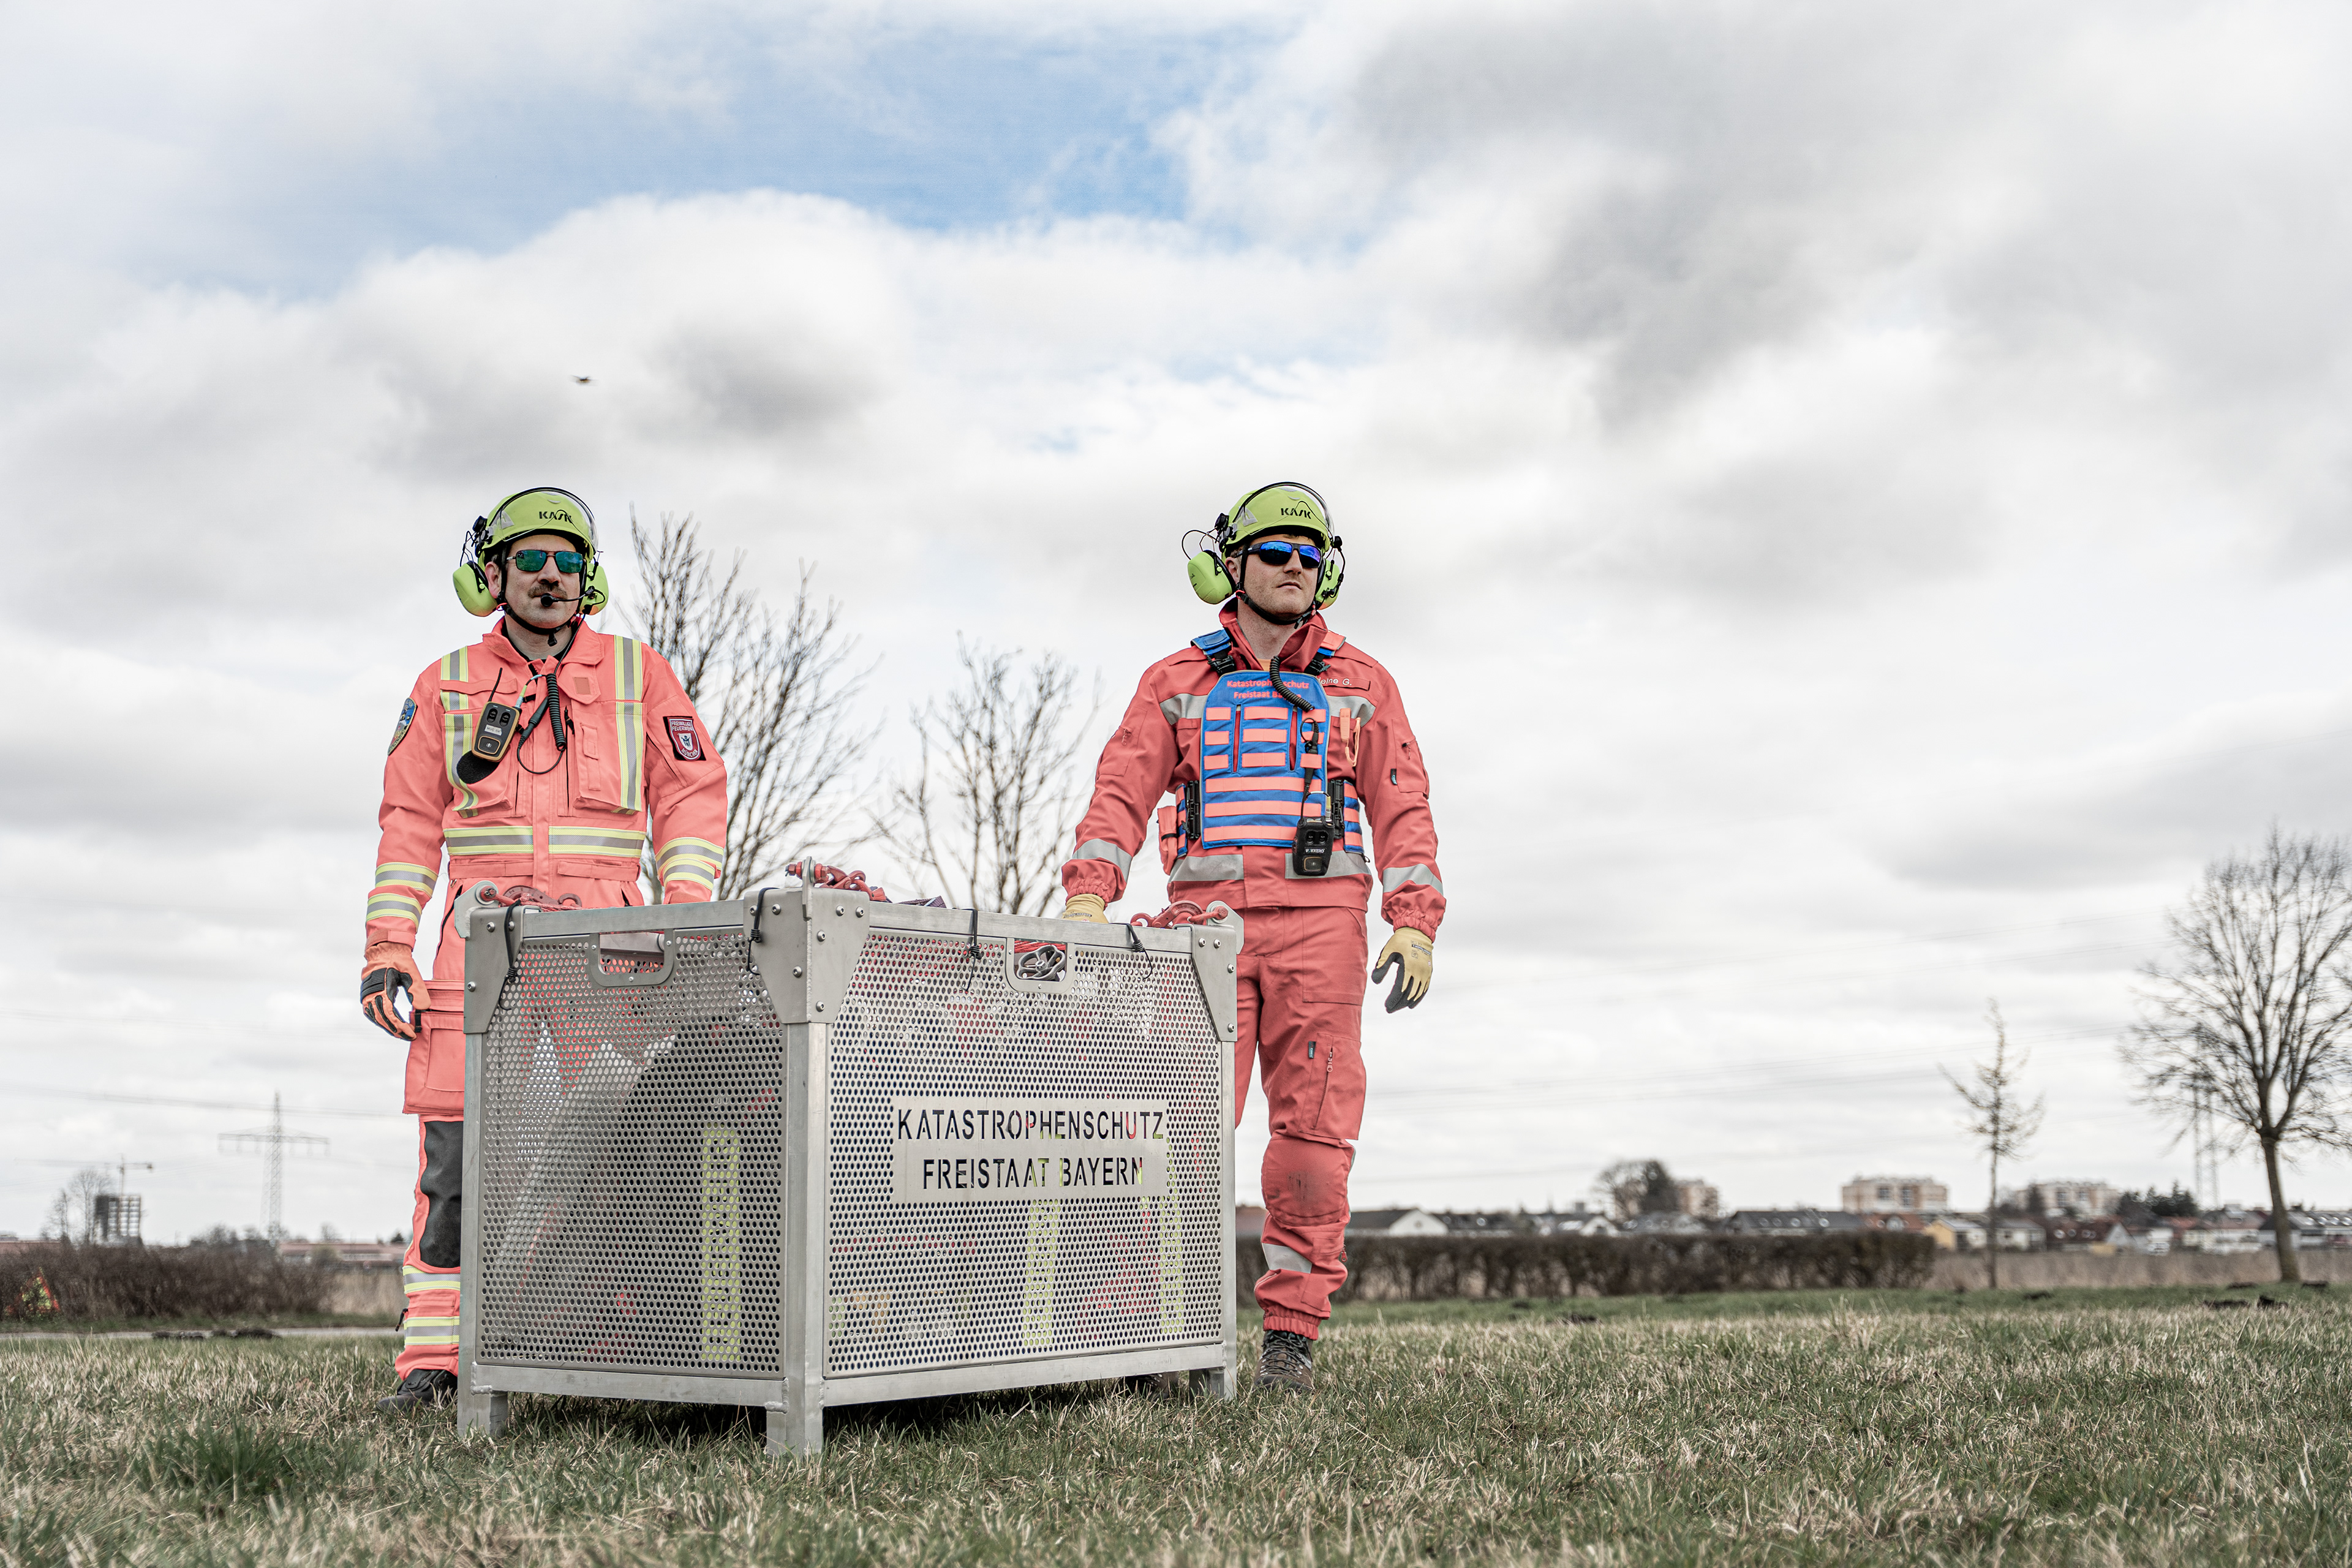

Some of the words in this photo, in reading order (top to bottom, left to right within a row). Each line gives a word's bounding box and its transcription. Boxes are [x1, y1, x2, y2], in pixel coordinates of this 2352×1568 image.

[539, 511, 571, 523] KASK
[1281, 508, 1311, 519] KASK
[1227, 679, 1310, 689] Katastrophschutz
[898, 1109, 1164, 1140] KATASTROPHENSCHUTZ
[923, 1158, 1050, 1189] FREISTAAT
[1060, 1157, 1143, 1188] BAYERN
